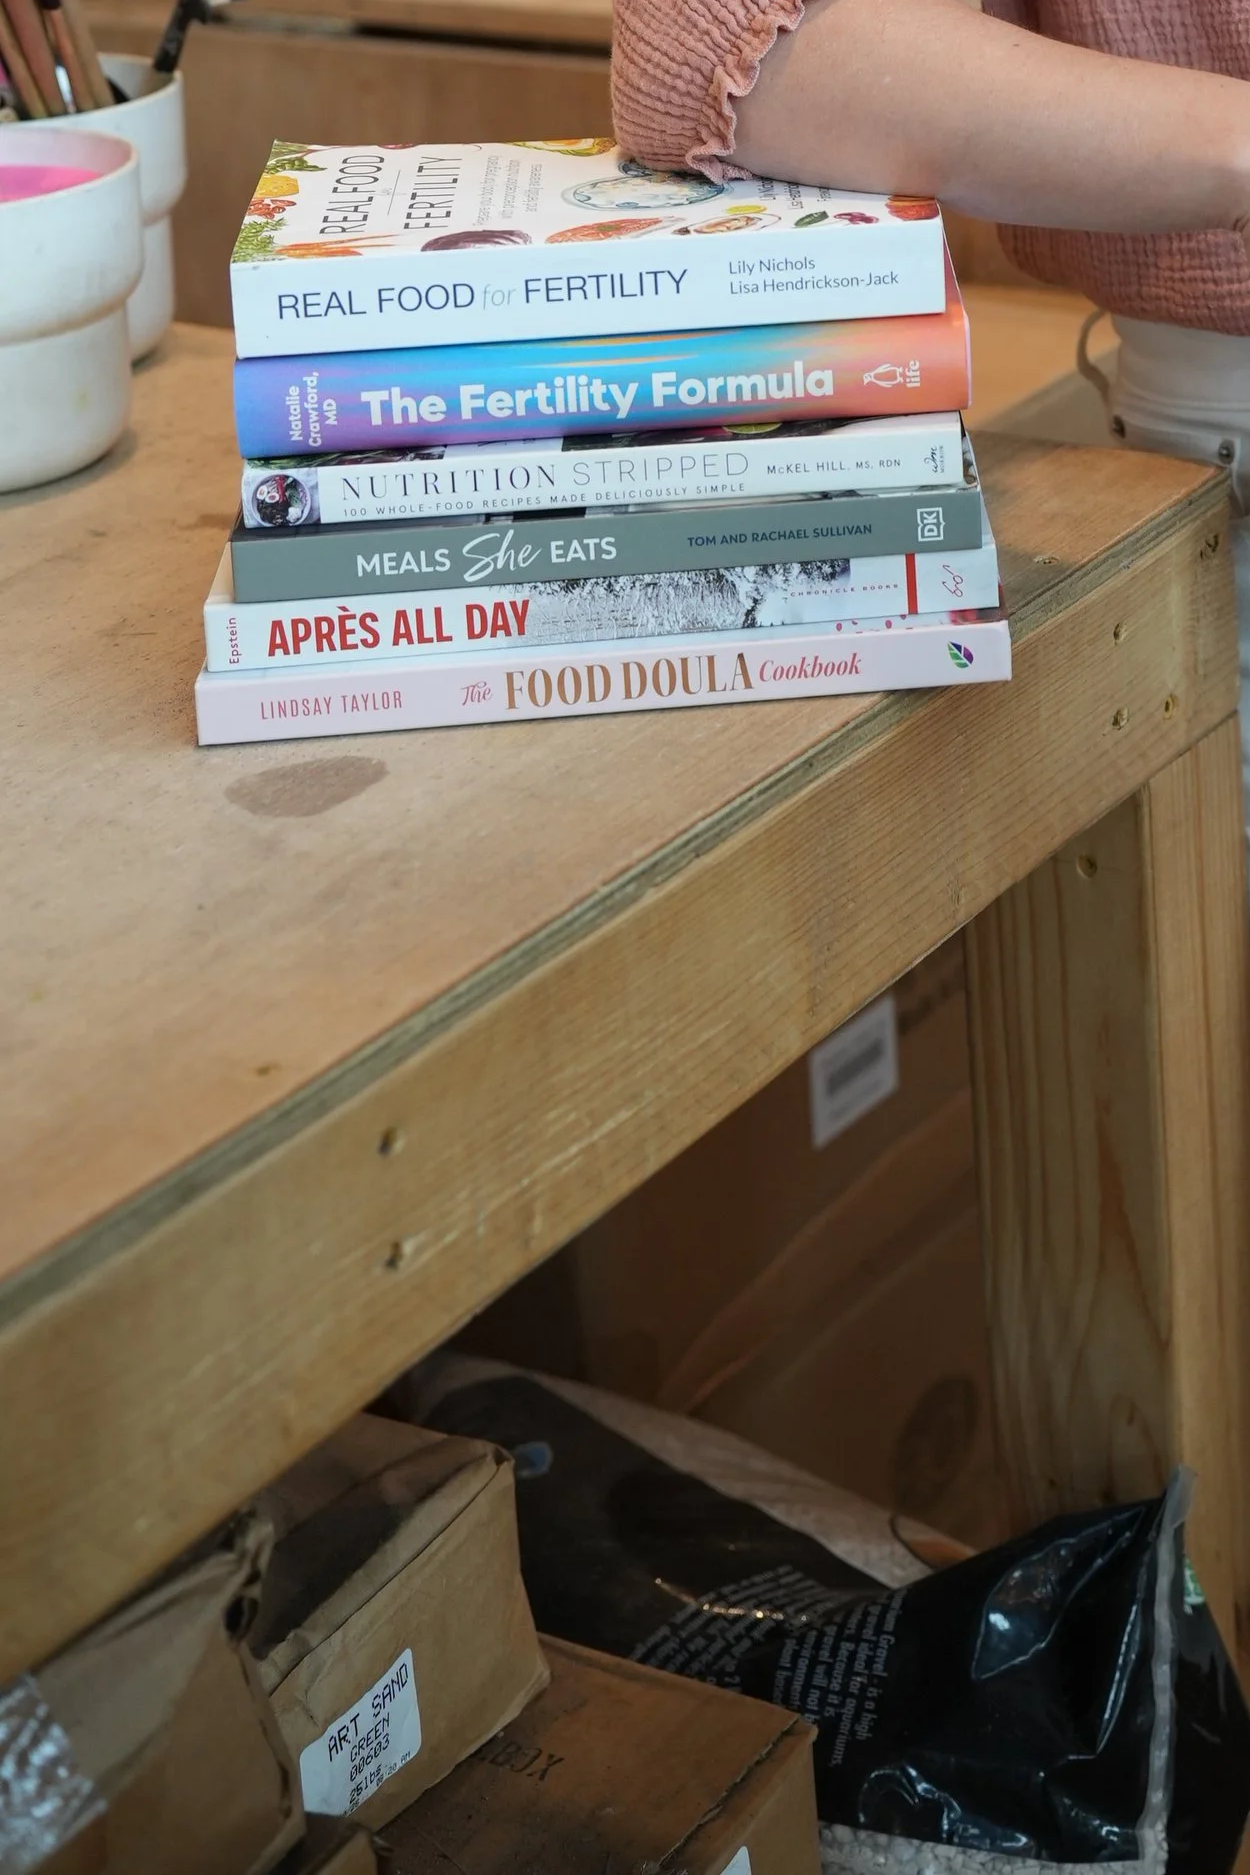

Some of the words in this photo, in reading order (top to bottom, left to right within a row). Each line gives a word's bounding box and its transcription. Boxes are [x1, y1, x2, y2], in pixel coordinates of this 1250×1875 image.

[332, 155, 385, 193] FOOD
[404, 156, 462, 229] FERTILITY
[319, 196, 374, 234] REAL
[729, 259, 755, 276] Lily
[759, 256, 816, 272] Nichols
[730, 280, 759, 294] Lisa
[763, 271, 899, 293] Hendrickson-Jack
[278, 290, 367, 319] REAL
[378, 283, 475, 313] FOOD
[481, 284, 517, 310] for
[524, 269, 688, 303] FERTILITY
[360, 387, 447, 425] The
[459, 375, 639, 419] Fertility
[651, 360, 834, 407] Formula
[905, 360, 921, 388] life
[285, 385, 304, 441] Natalie
[302, 371, 322, 447] Crawford,
[322, 398, 338, 425] MD
[342, 464, 556, 501] NUTRITION
[573, 452, 749, 486] STRIPPED
[767, 463, 810, 475] McKEL
[879, 458, 901, 468] RDN
[343, 507, 367, 517] 100
[375, 500, 474, 515] WHOLE-FOOD
[482, 496, 541, 508] RECIPES
[549, 493, 587, 503] MADE
[596, 487, 688, 501] DELICIOUSLY
[696, 483, 745, 494] SIMPLE
[688, 535, 717, 547] TOM
[720, 533, 748, 545] AND
[751, 528, 810, 543] RACHAEL
[813, 524, 872, 539] SULLIVAN
[921, 510, 940, 538] DK
[357, 549, 450, 577] MEALS
[462, 529, 542, 583] She
[550, 537, 617, 563] EATS
[790, 587, 855, 597] CHRONICLE
[229, 617, 243, 664] Epstein
[267, 606, 380, 657] APRÈS
[392, 606, 453, 646] ALL
[465, 599, 530, 640] DAY
[460, 681, 493, 707] The
[505, 664, 612, 710] FOOD
[621, 652, 755, 701] DOULA
[759, 652, 862, 682] Cookbook
[260, 696, 332, 720] LINDSAY
[342, 690, 403, 714] TAYLOR
[811, 1665, 829, 1687] will
[829, 1641, 856, 1692] Because
[872, 1634, 896, 1677] Gravel
[328, 1713, 361, 1762] ART
[372, 1662, 409, 1718] SAND
[854, 1713, 878, 1740] high
[350, 1732, 390, 1782] 00603
[351, 1712, 390, 1763] GREEN
